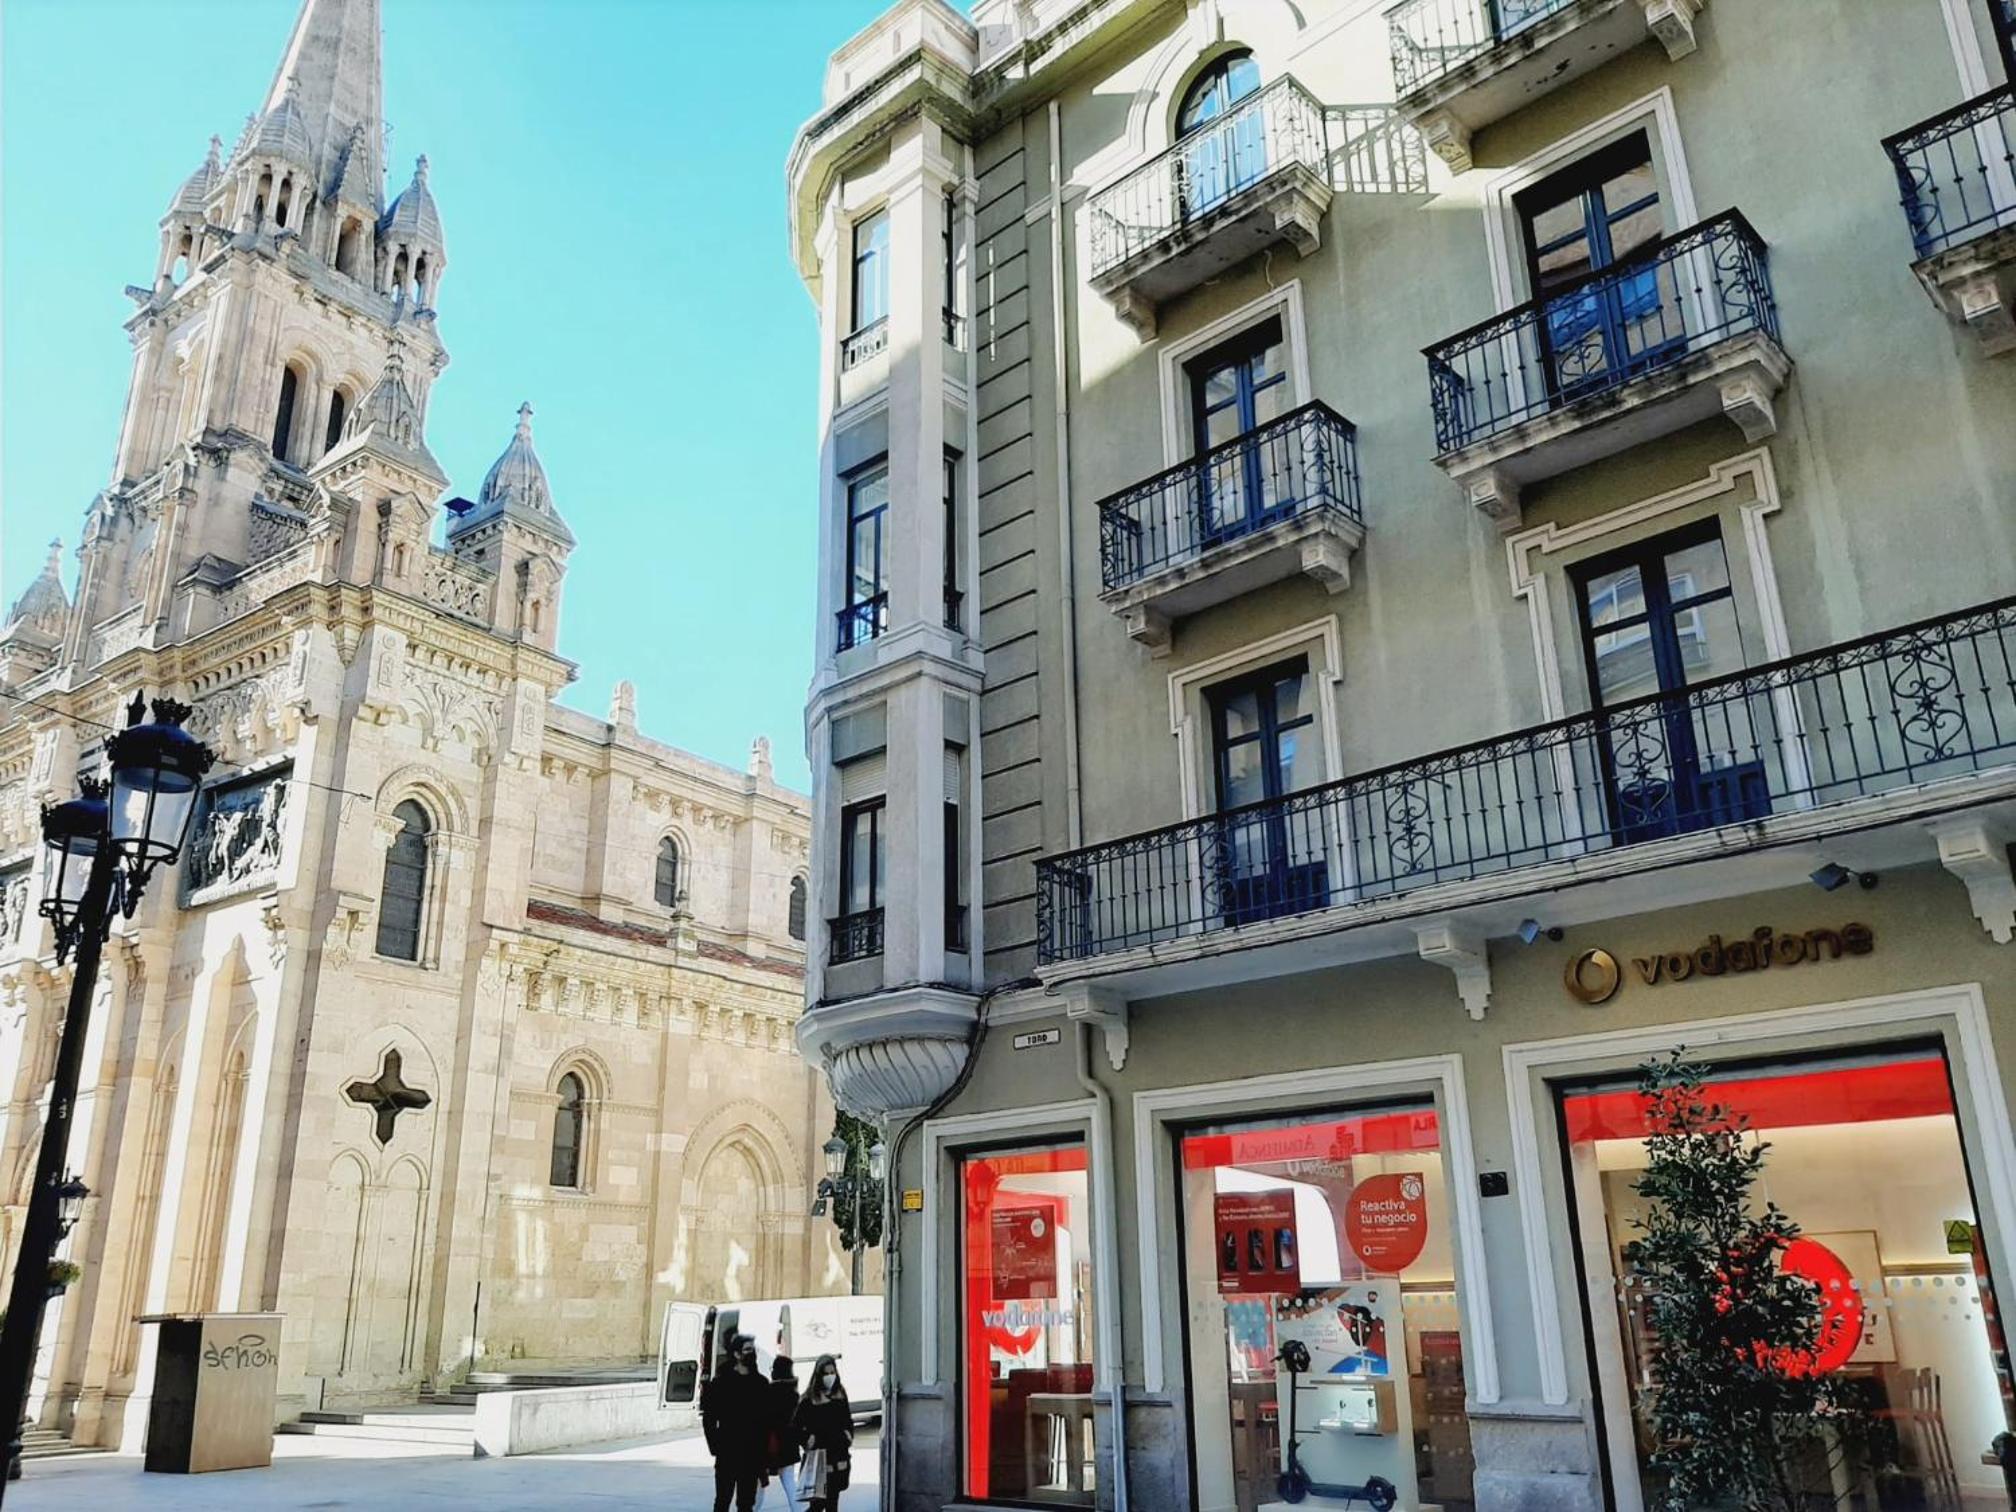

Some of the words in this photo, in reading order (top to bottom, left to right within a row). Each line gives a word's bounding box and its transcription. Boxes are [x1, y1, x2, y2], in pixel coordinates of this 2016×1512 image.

[1631, 922, 1874, 985] vodafone
[1360, 1199, 1406, 1212] Reactiva
[1361, 1214, 1372, 1224] tu
[1374, 1211, 1417, 1226] negocio
